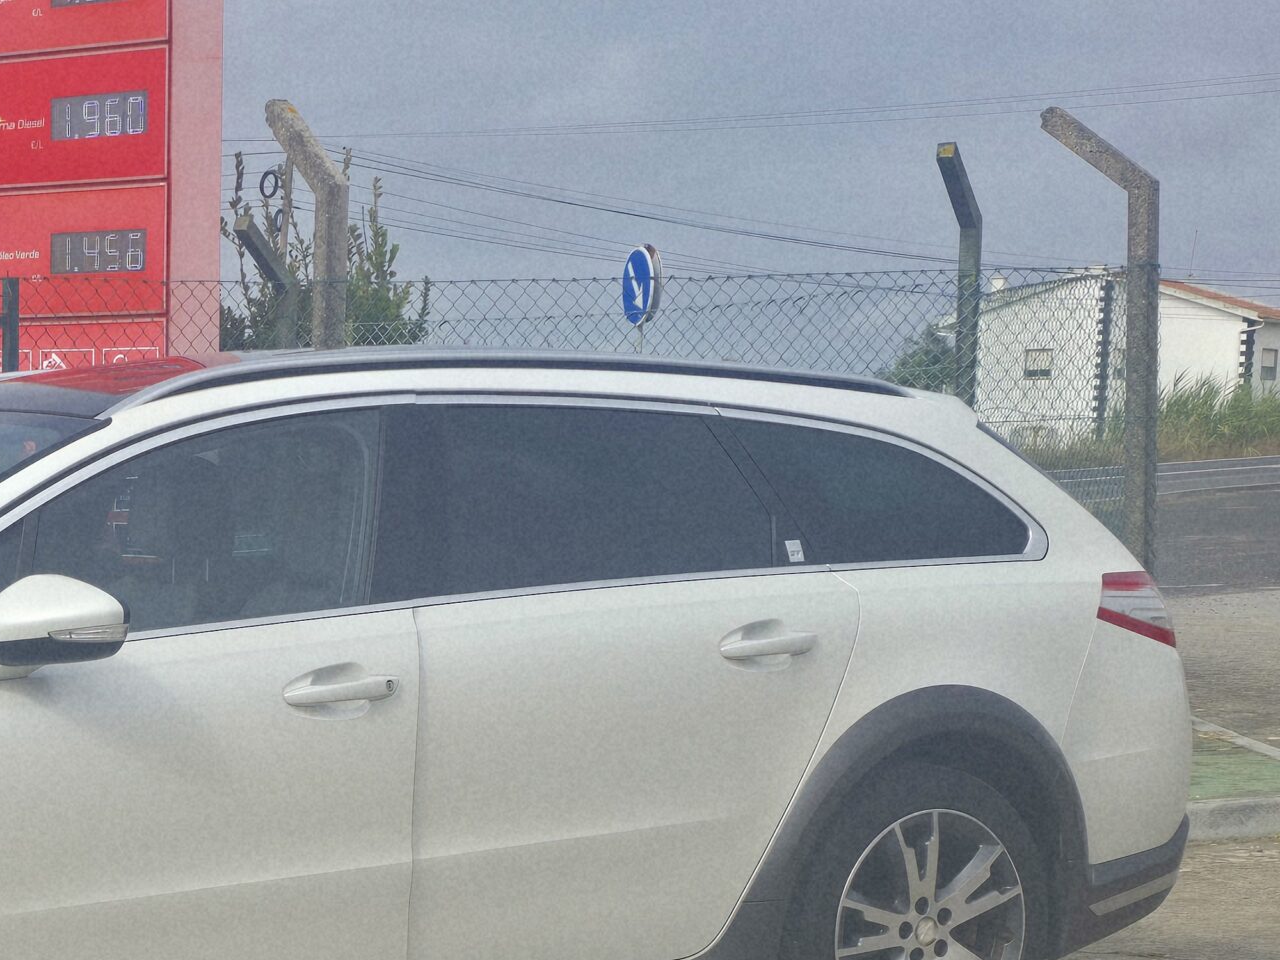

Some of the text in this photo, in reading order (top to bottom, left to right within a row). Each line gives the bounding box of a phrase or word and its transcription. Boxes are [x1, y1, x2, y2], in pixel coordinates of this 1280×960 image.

[17, 117, 45, 130] Diesel
[65, 96, 144, 139] 1.960
[16, 249, 40, 259] Verde
[65, 233, 144, 272] 1.456
